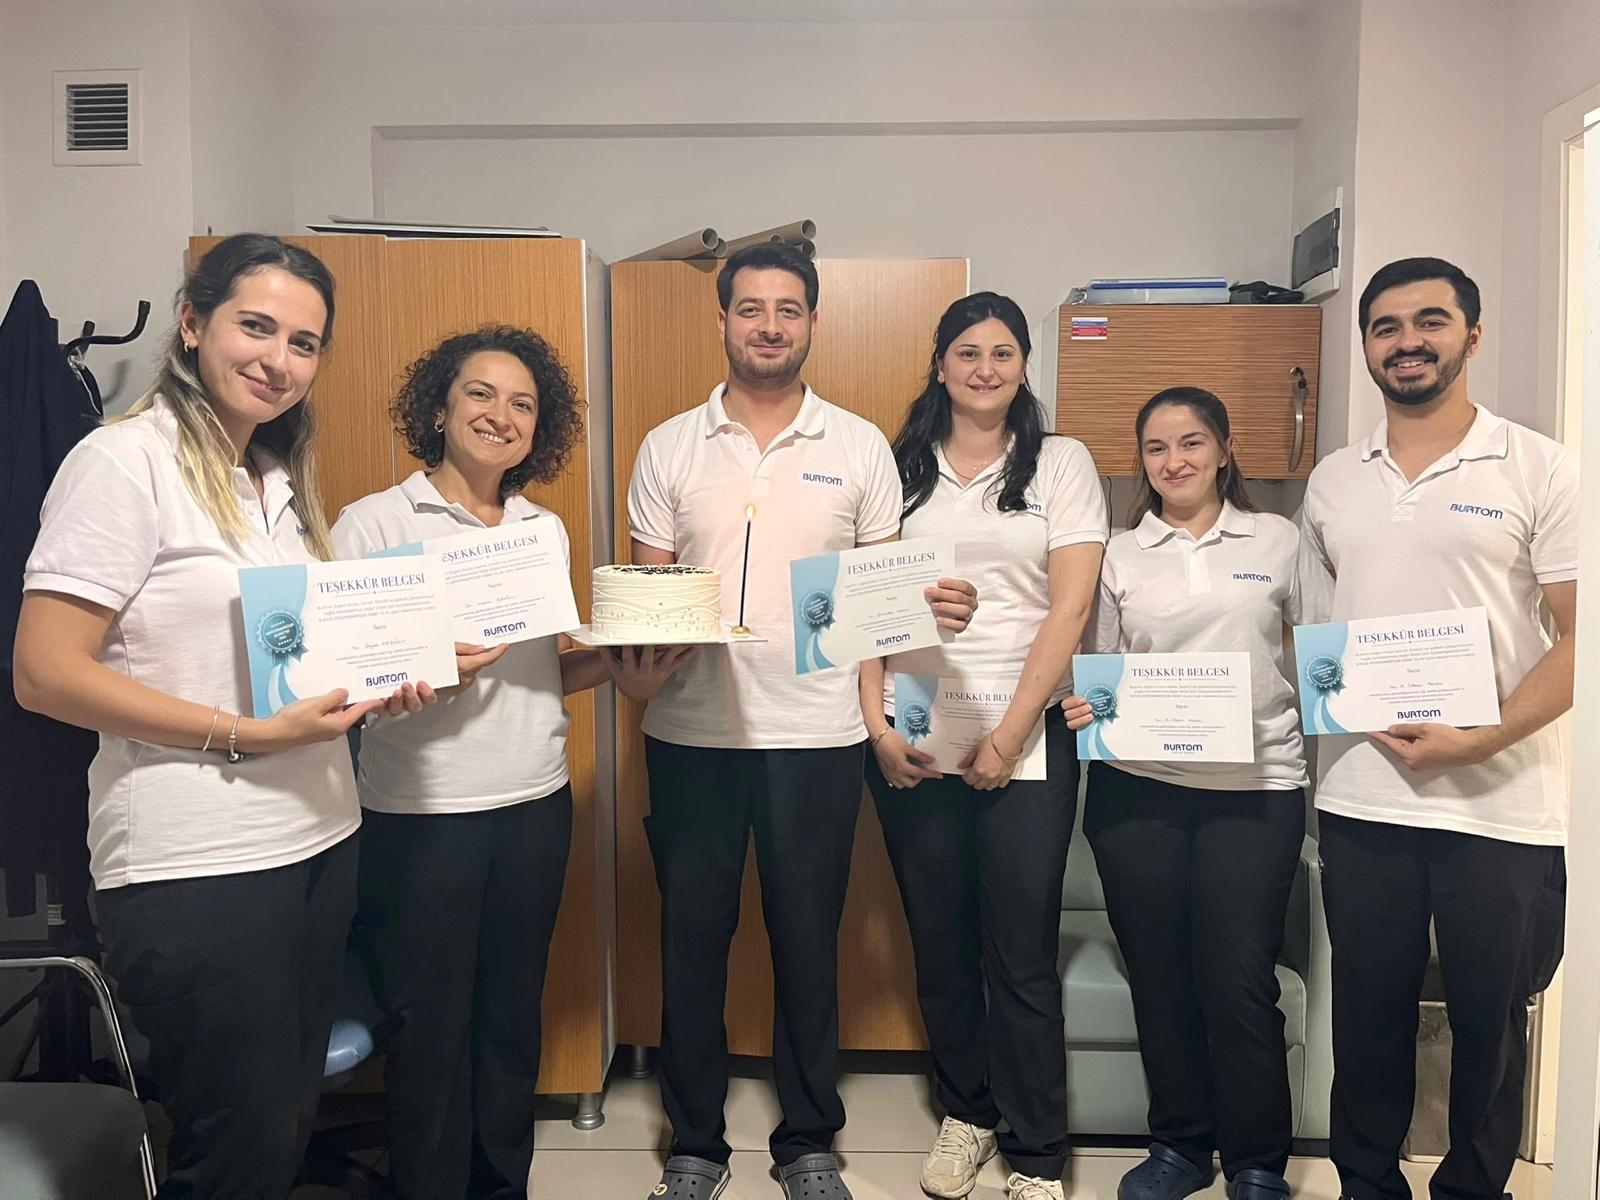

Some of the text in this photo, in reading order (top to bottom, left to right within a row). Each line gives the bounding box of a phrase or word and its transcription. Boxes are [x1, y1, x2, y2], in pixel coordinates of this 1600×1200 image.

[442, 543, 492, 563] EŞEKKÜR
[317, 576, 379, 595] TEŞEKKÜR
[1356, 623, 1465, 645] TEŞEKKÜR BELGESİ
[1131, 666, 1185, 679] TEŞEKKÜR
